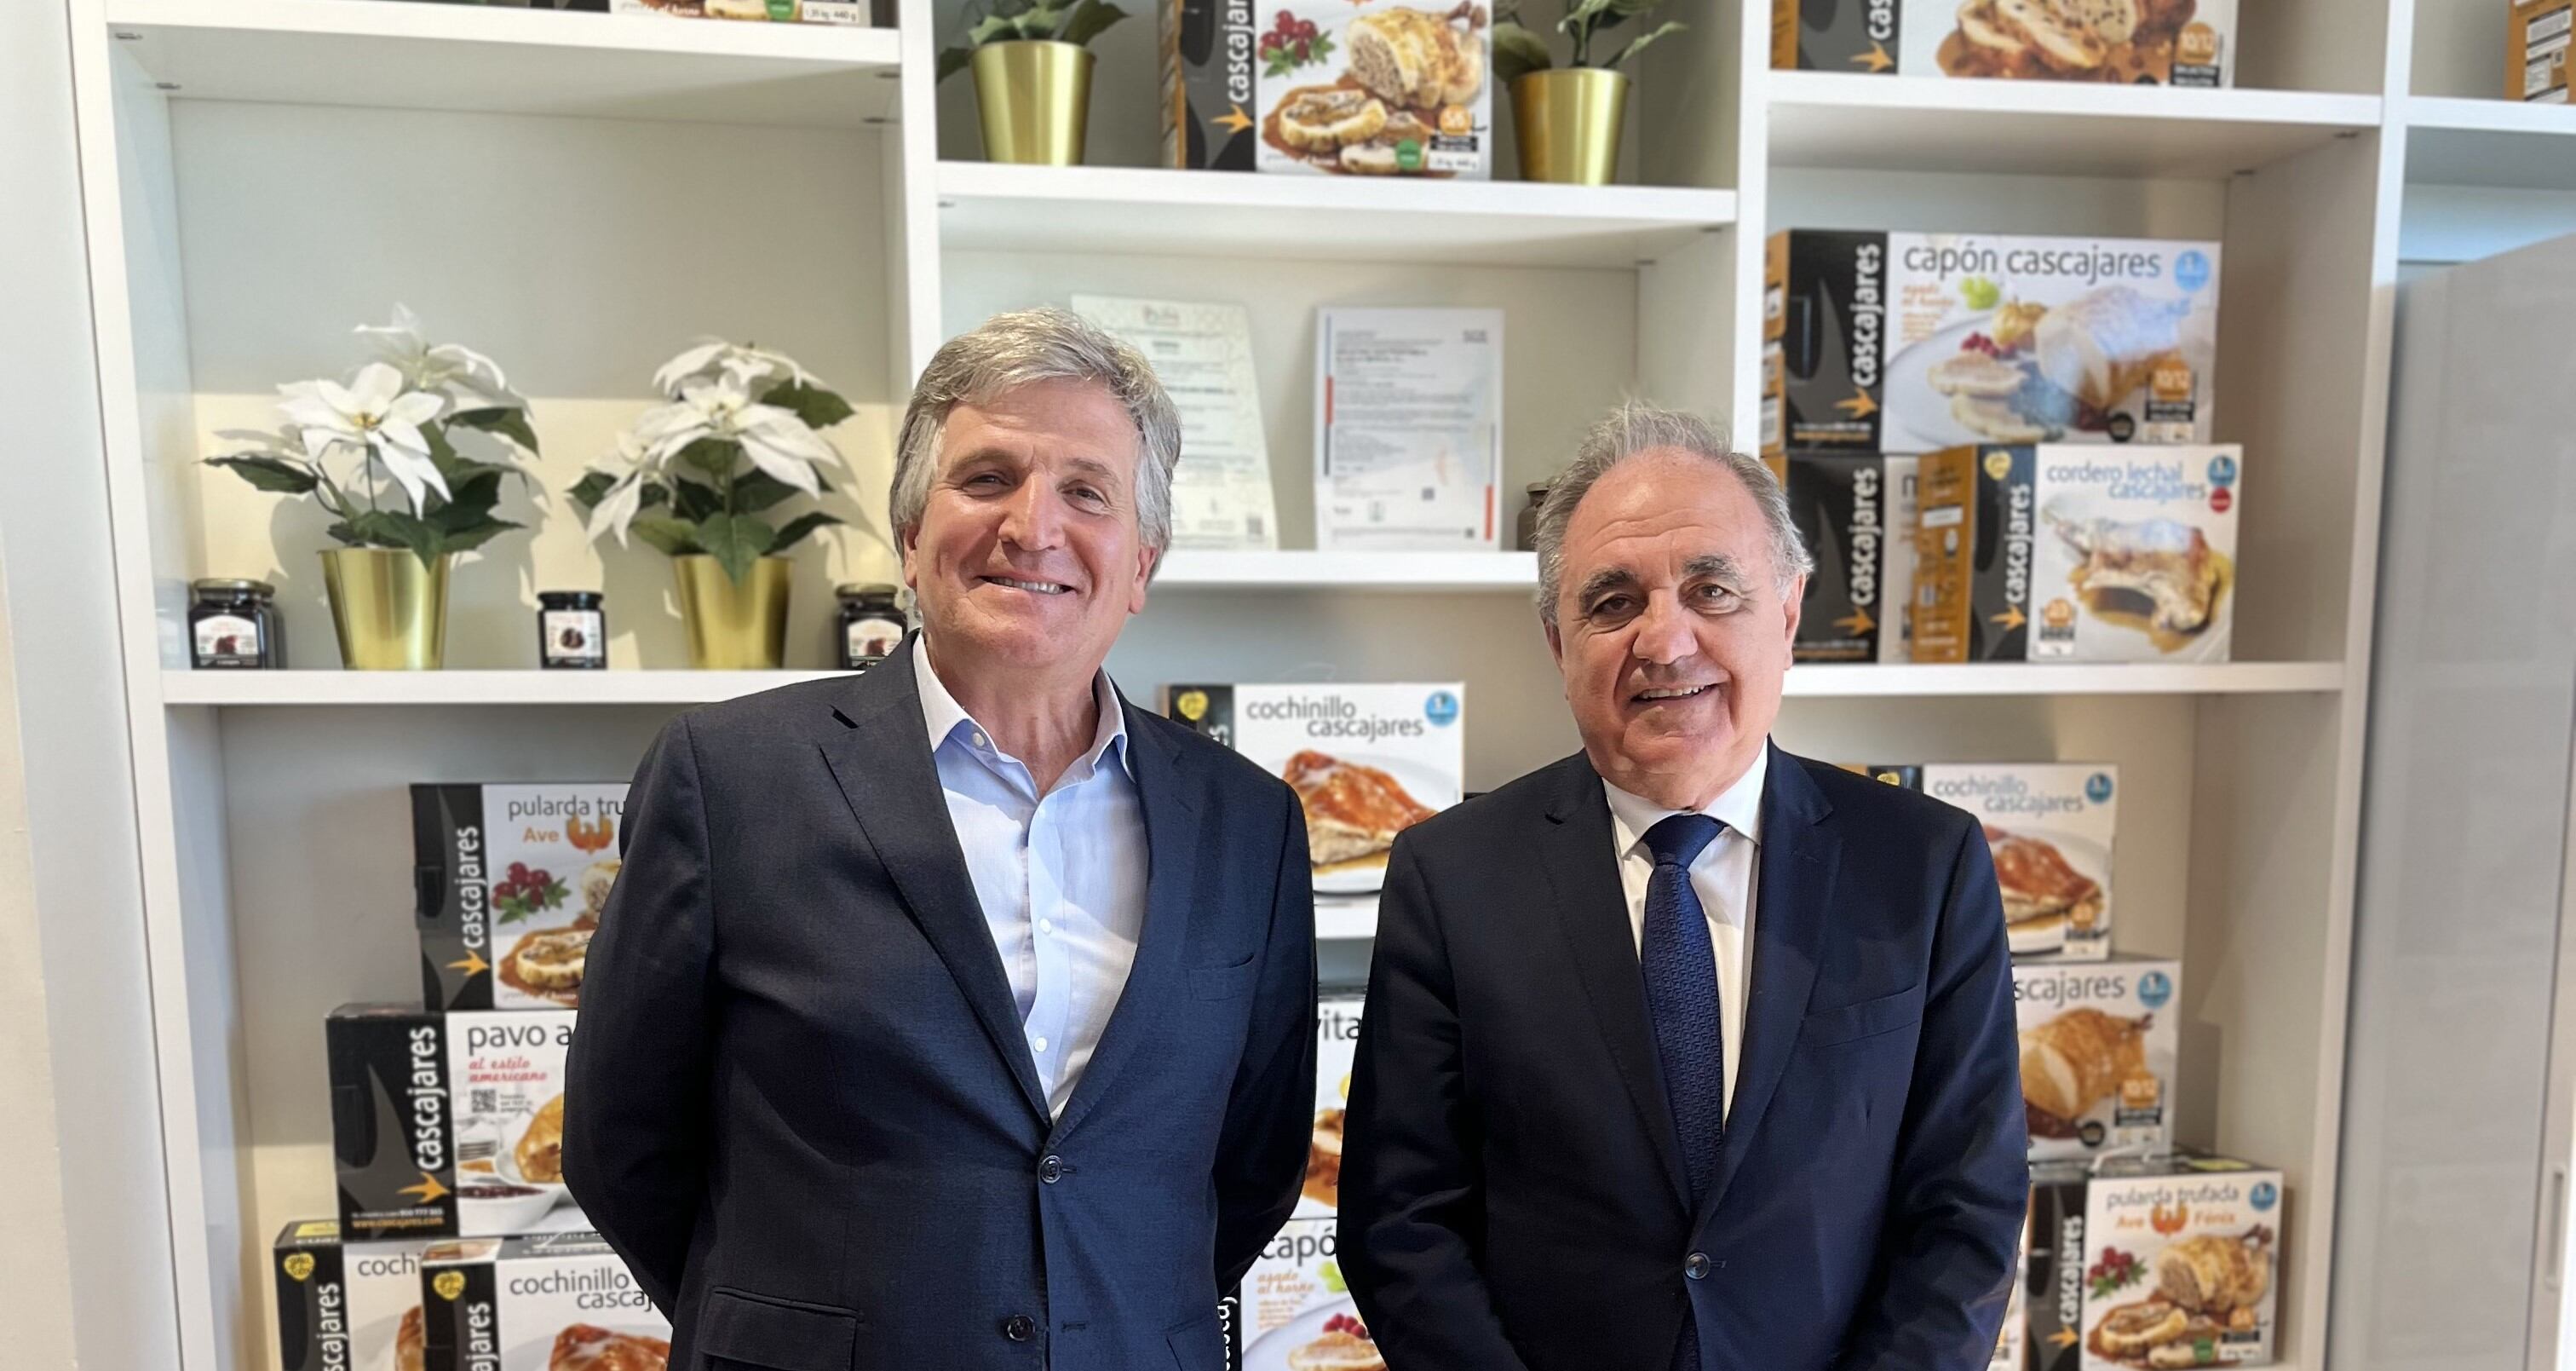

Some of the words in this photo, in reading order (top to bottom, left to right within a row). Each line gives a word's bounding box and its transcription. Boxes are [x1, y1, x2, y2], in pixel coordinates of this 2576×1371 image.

[1903, 240, 1998, 281] capón
[2006, 245, 2162, 285] cascajares
[1849, 243, 1885, 387] cascajares
[2047, 459, 2123, 482] cordero
[2127, 459, 2184, 482] lechal
[2108, 481, 2205, 505] cascajares
[1848, 467, 1883, 606] cascajares
[2004, 482, 2034, 604] cascajares
[1246, 695, 1356, 720] cochinillo
[1307, 715, 1424, 744] cascajares
[1934, 774, 2027, 797] cochinillo
[508, 794, 590, 821] pularda
[1984, 792, 2084, 817] cascajares
[522, 827, 561, 844] Ave
[455, 825, 488, 948] cascajares
[468, 1025, 546, 1057] pavo
[469, 1057, 484, 1070] al
[491, 1056, 530, 1070] estilo
[469, 1072, 547, 1083] americano
[407, 1025, 446, 1171] cascajares
[2107, 1186, 2172, 1212] pularda
[2178, 1183, 2240, 1203] trufada
[2117, 1215, 2145, 1229] Ave
[510, 1267, 630, 1296] cochinillo
[2058, 1214, 2085, 1324] cascajares
